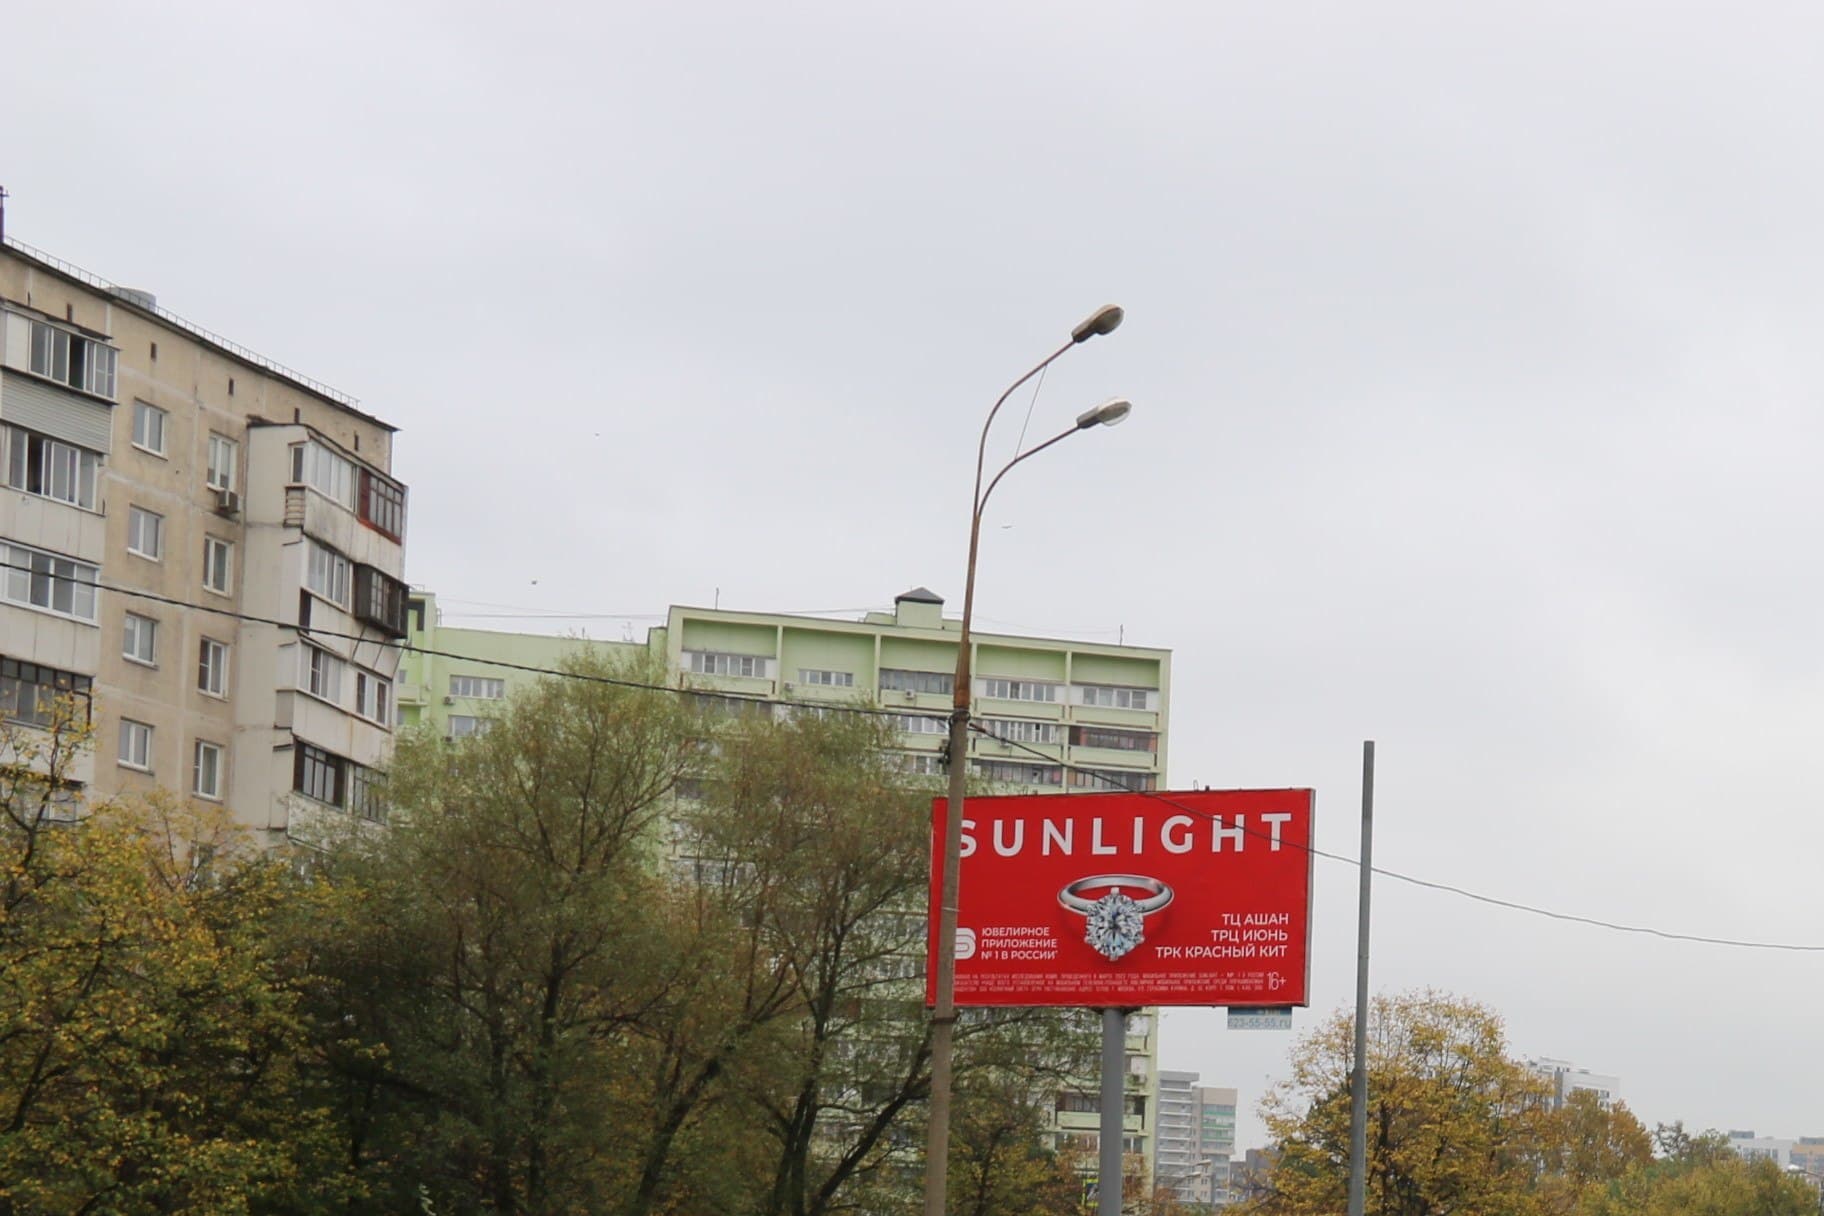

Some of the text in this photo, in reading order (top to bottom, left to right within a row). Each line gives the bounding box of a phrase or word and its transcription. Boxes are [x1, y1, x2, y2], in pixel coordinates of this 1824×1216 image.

[958, 812, 1292, 858] SUNLIGHT
[1221, 913, 1289, 928] ТЦ АШАН
[981, 926, 1050, 938] ЮВЕЛИРНОЕ
[1211, 928, 1289, 943] ТРЦ ИЮНЬ
[981, 938, 1058, 949] ПРИЛОЖЕНИЕ
[1155, 943, 1288, 959] ТРК КРАСНЫЙ КИТ
[1001, 950, 1009, 961] В
[1267, 971, 1287, 991] 16+
